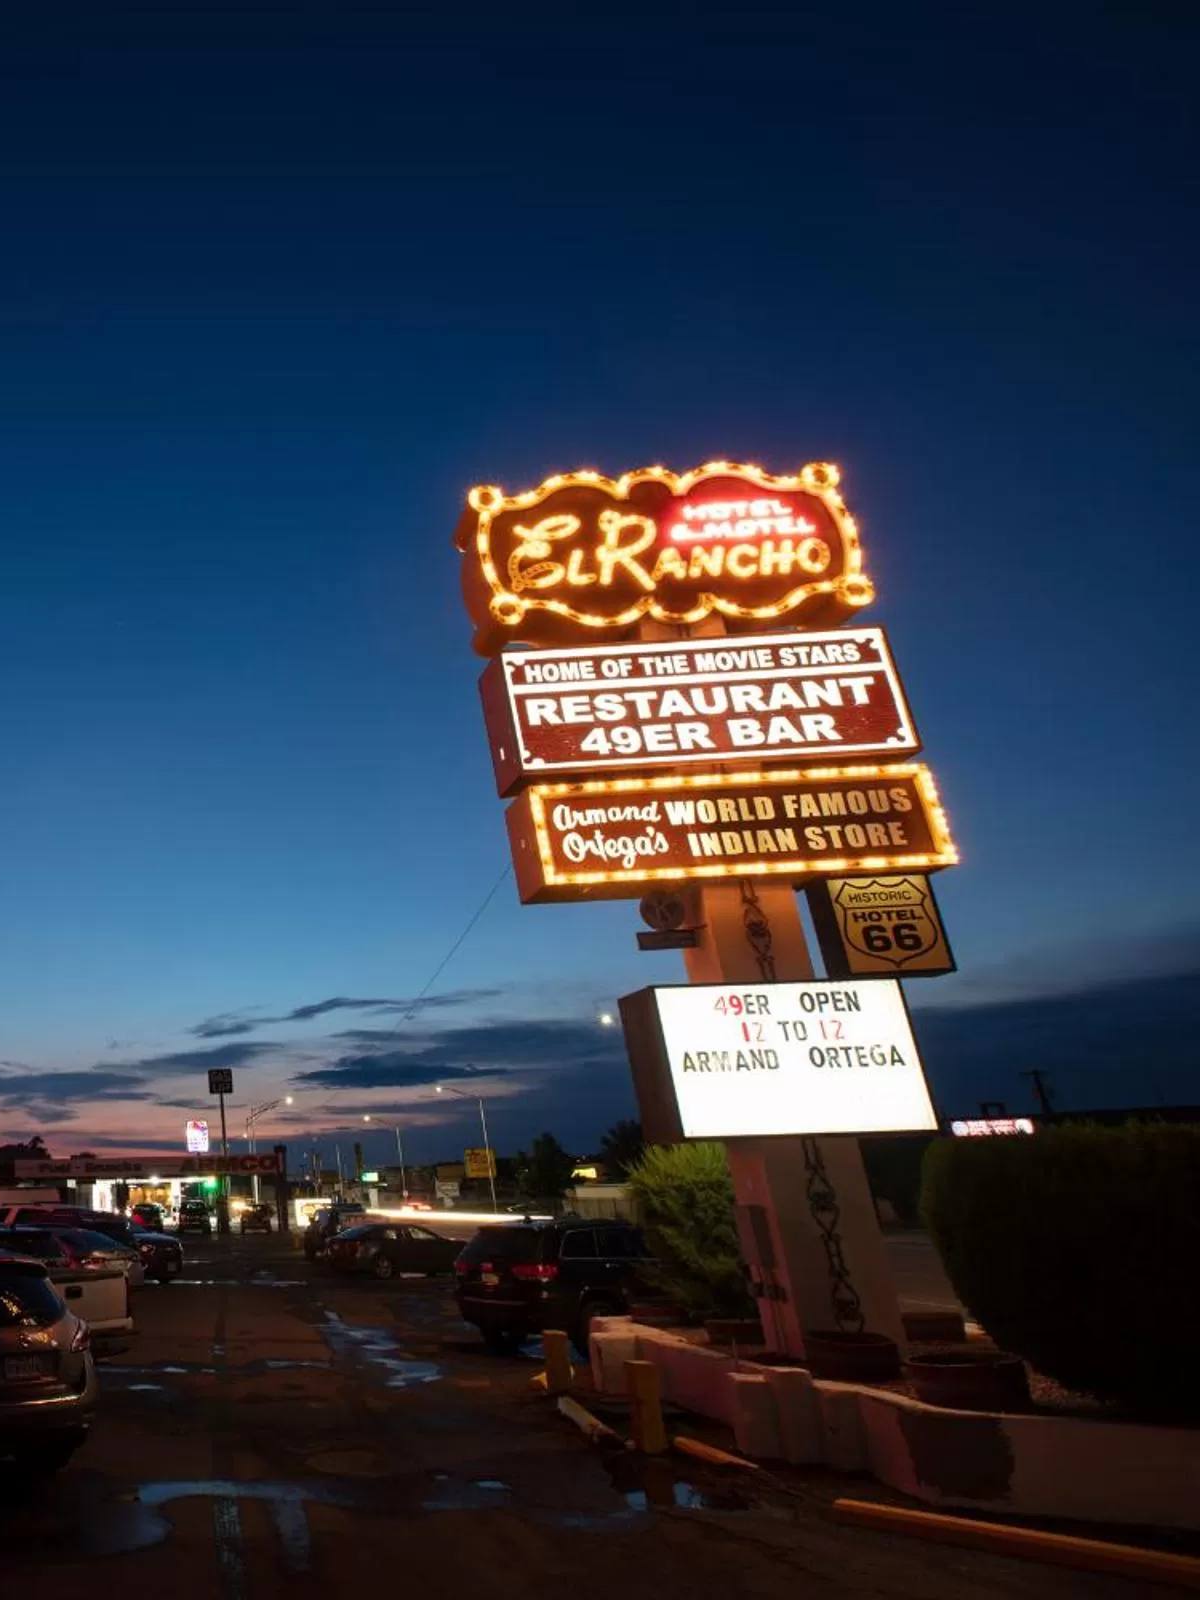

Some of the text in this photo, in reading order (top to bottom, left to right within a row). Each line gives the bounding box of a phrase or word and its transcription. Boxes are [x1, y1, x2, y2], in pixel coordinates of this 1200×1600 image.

[682, 499, 793, 520] HOTEL
[703, 516, 816, 538] MOTEL
[596, 509, 831, 590] RANCHO
[524, 643, 860, 684] HOME OF THE MOVIE STARS
[525, 676, 875, 726] RESTAURANT
[579, 713, 842, 756] 49ER BAR
[552, 800, 662, 832] Armand
[664, 787, 913, 827] WORLD FAMOUS
[562, 826, 669, 869] Ortega's
[686, 821, 908, 858] INDIAN STORE
[848, 890, 912, 903] HISTORIC
[851, 908, 924, 922] HOTEL
[862, 923, 923, 952] 66
[713, 990, 862, 1015] 49ER OPEN
[741, 1019, 846, 1042] 12 TO 12
[682, 1044, 907, 1073] ARMAND ORTEGA
